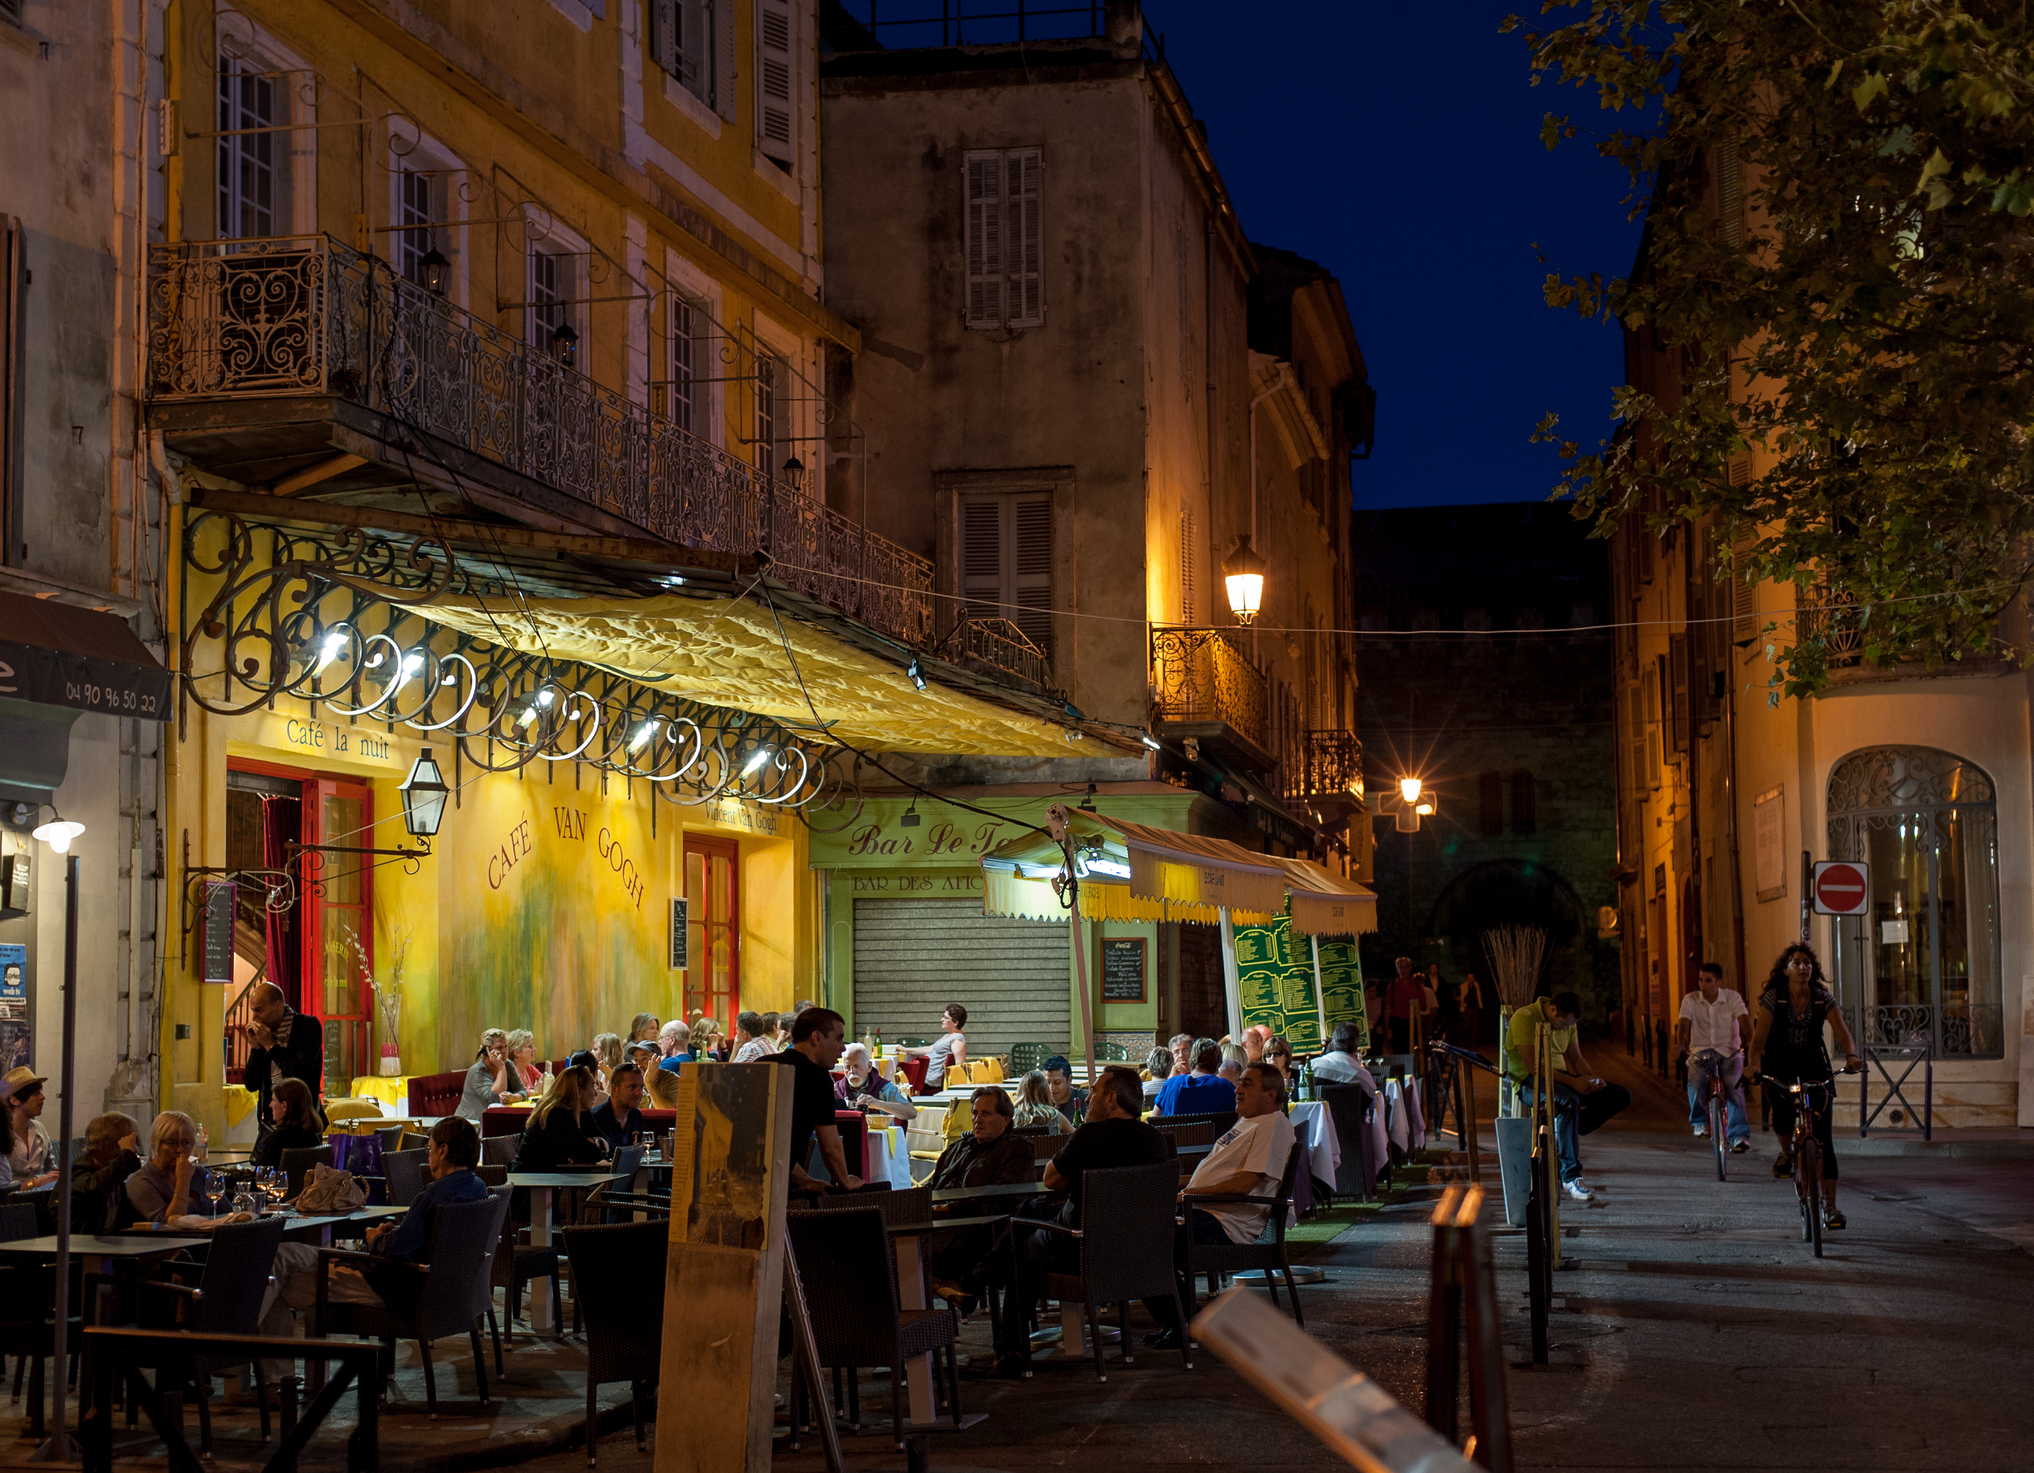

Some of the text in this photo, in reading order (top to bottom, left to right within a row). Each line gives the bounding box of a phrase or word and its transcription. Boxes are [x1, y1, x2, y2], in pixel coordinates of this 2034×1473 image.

[66, 681, 156, 713] 04 90 96 50 22
[286, 719, 389, 760] Café la nuit
[705, 800, 778, 836] Vincent Van Gogh
[848, 823, 915, 856] Bar
[924, 823, 964, 856] Le
[487, 806, 645, 911] CAFÉ VAN GOGH
[852, 875, 984, 891] BAR DES AFIC
